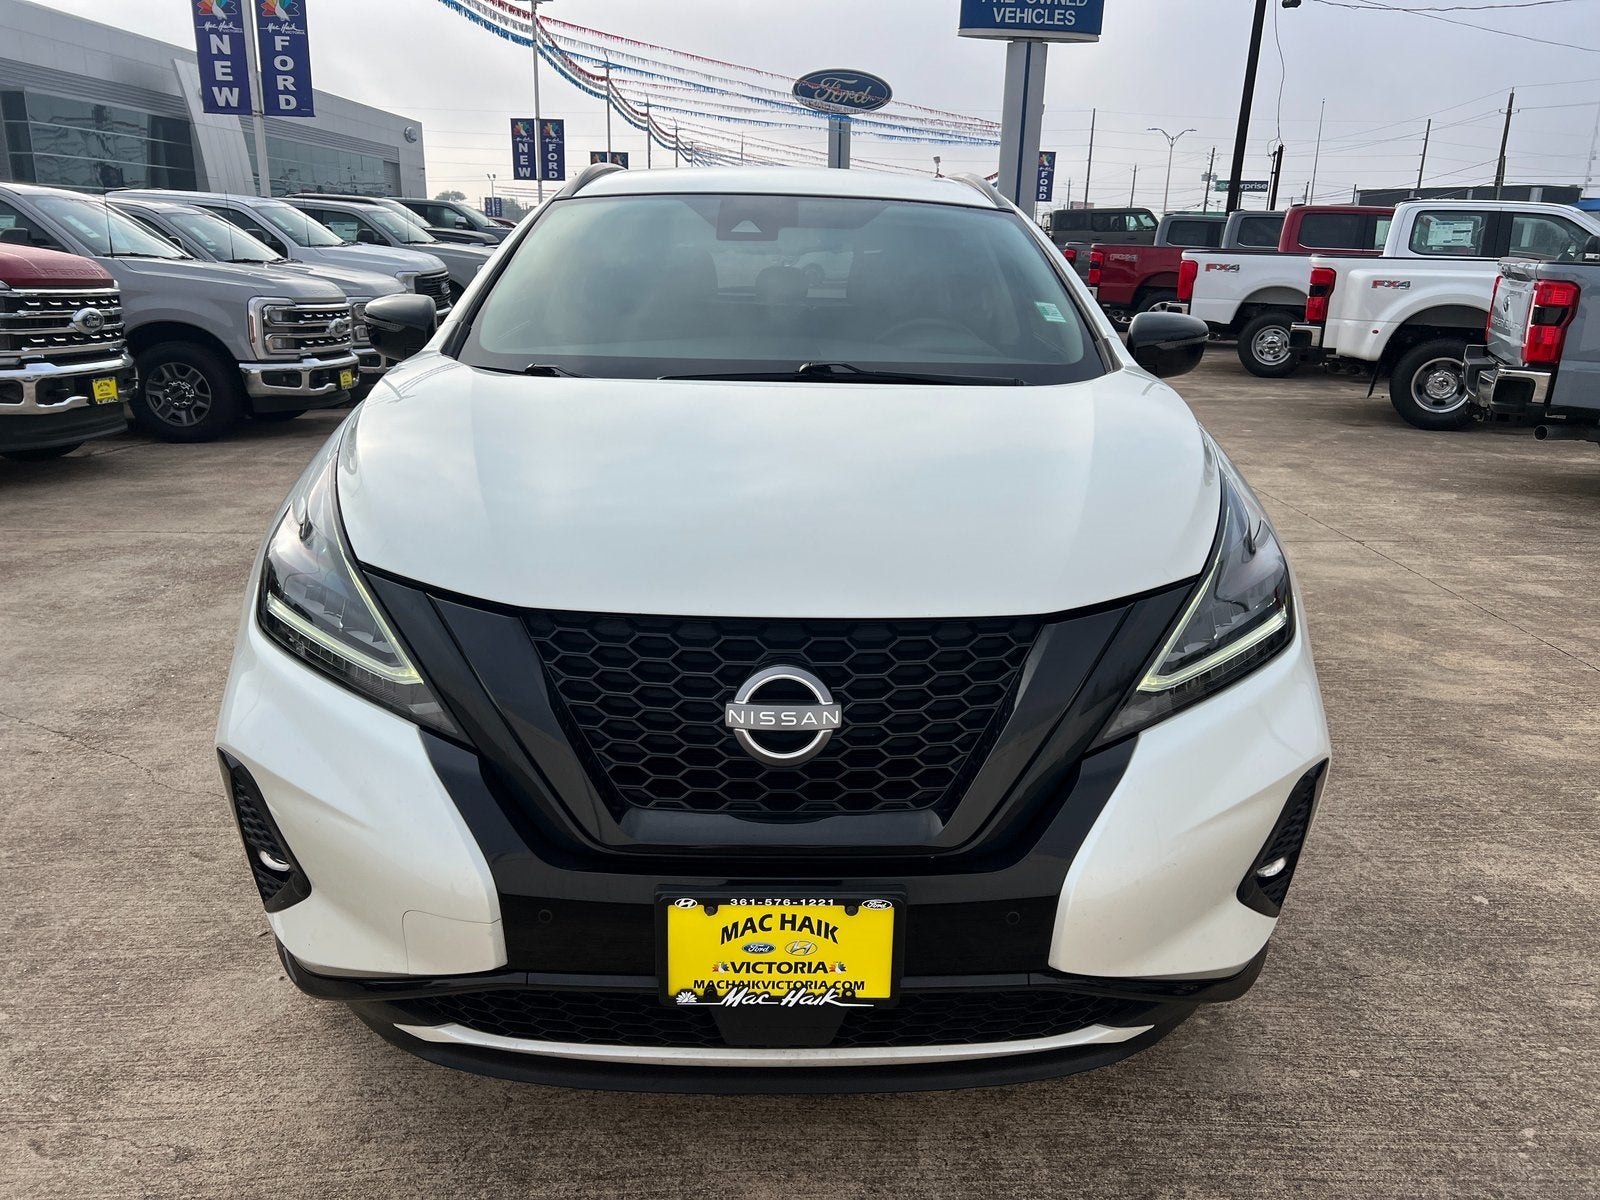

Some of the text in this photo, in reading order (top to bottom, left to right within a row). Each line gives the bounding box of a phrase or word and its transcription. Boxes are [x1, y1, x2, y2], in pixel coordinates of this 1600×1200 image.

[993, 8, 1076, 25] VEHICLES
[209, 34, 239, 107] NEW
[273, 35, 297, 110] FORD
[814, 77, 872, 104] Ford
[518, 143, 531, 177] NEW
[547, 143, 558, 179] FORD
[1039, 171, 1048, 200] FORD
[1204, 263, 1240, 272] FX4
[1371, 280, 1411, 290] FX4
[728, 709, 839, 726] NISSAN
[730, 898, 834, 906] 361-576-1221
[720, 914, 839, 945] MAC HAIK
[747, 943, 771, 953] Ford
[730, 962, 828, 974] VICTORIA
[693, 980, 865, 990] MACHAIKVICTORIA.COM
[720, 986, 848, 1007] Mac Haik
